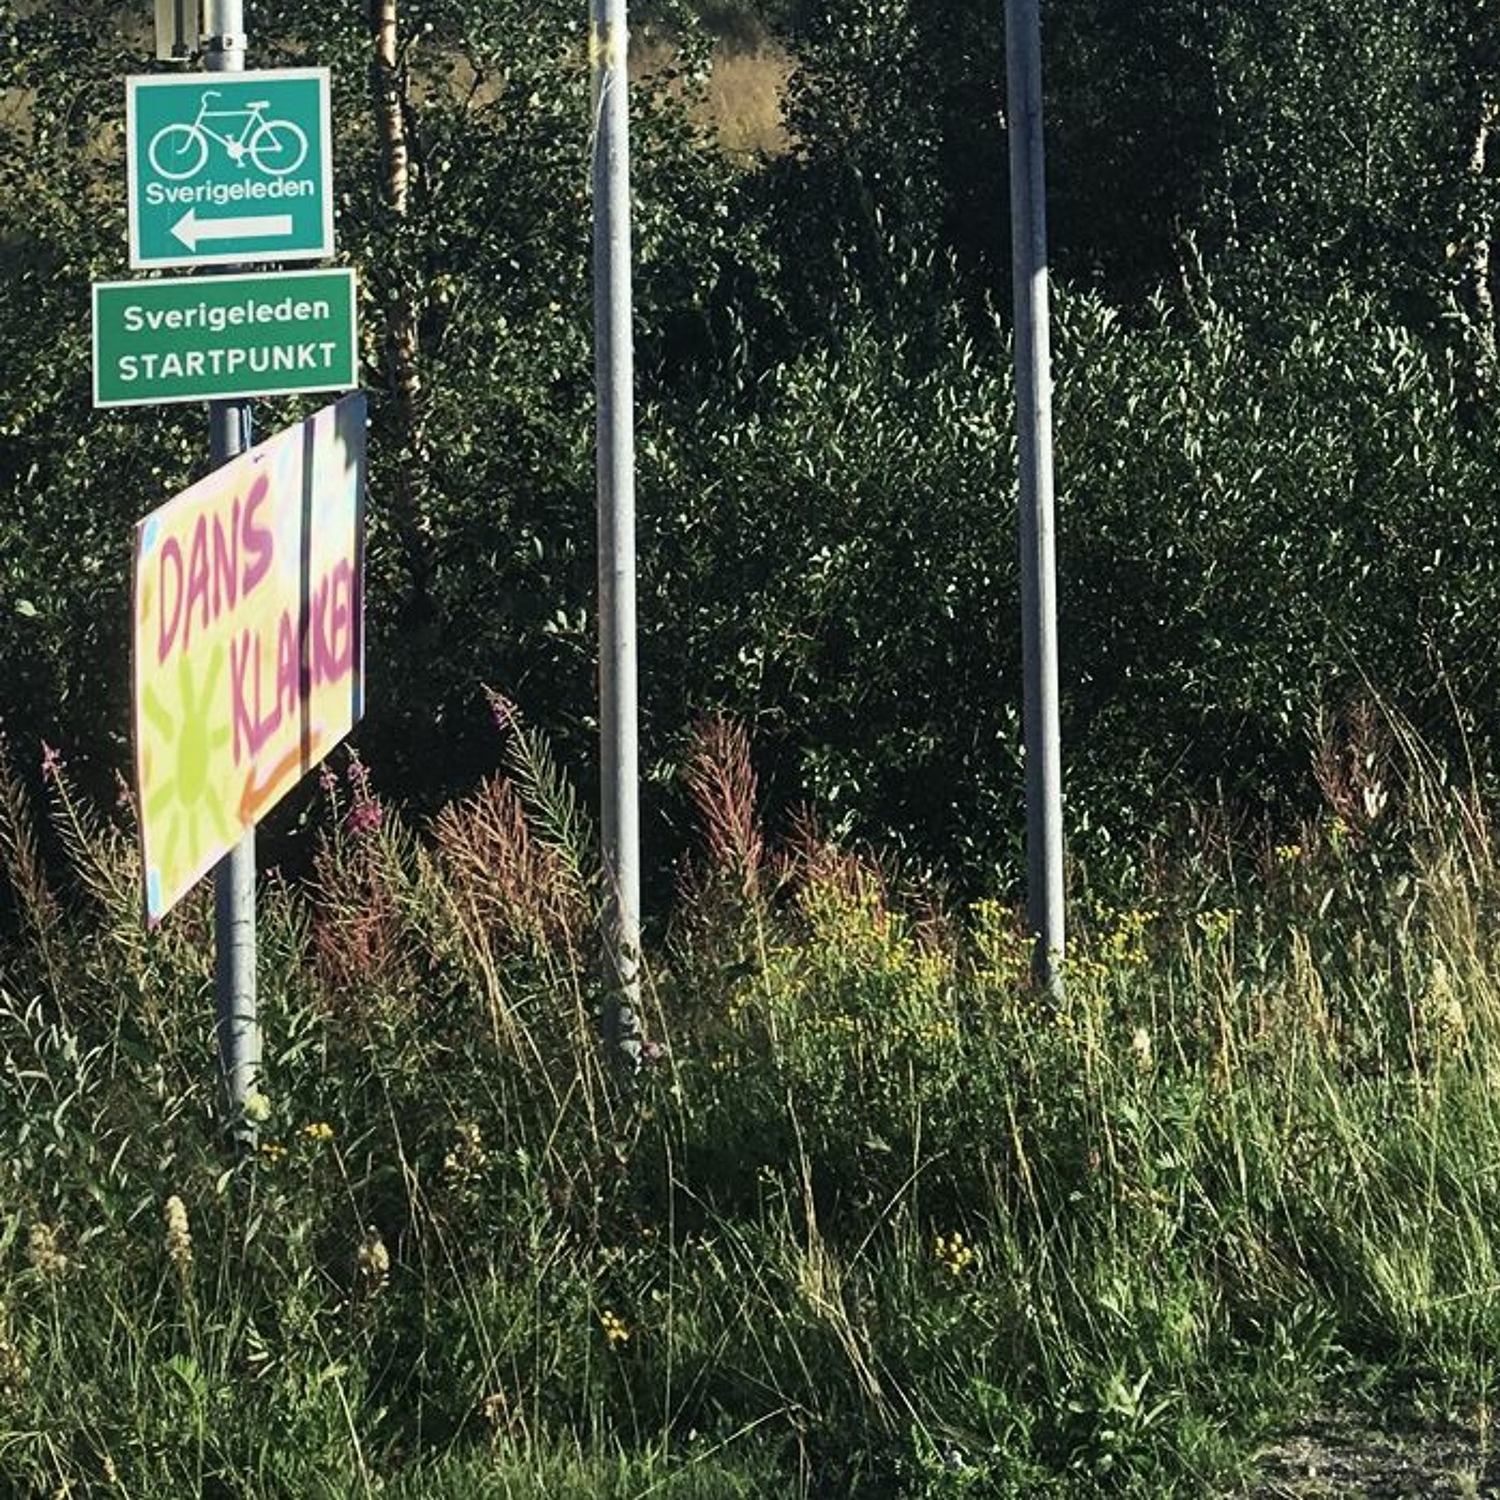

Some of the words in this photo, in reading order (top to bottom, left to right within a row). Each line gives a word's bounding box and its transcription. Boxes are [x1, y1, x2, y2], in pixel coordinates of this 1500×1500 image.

[145, 177, 315, 206] Sverigeleden
[123, 297, 330, 332] Sverigeleden
[118, 342, 337, 381] STARTPUNKT
[158, 473, 274, 665] DANS
